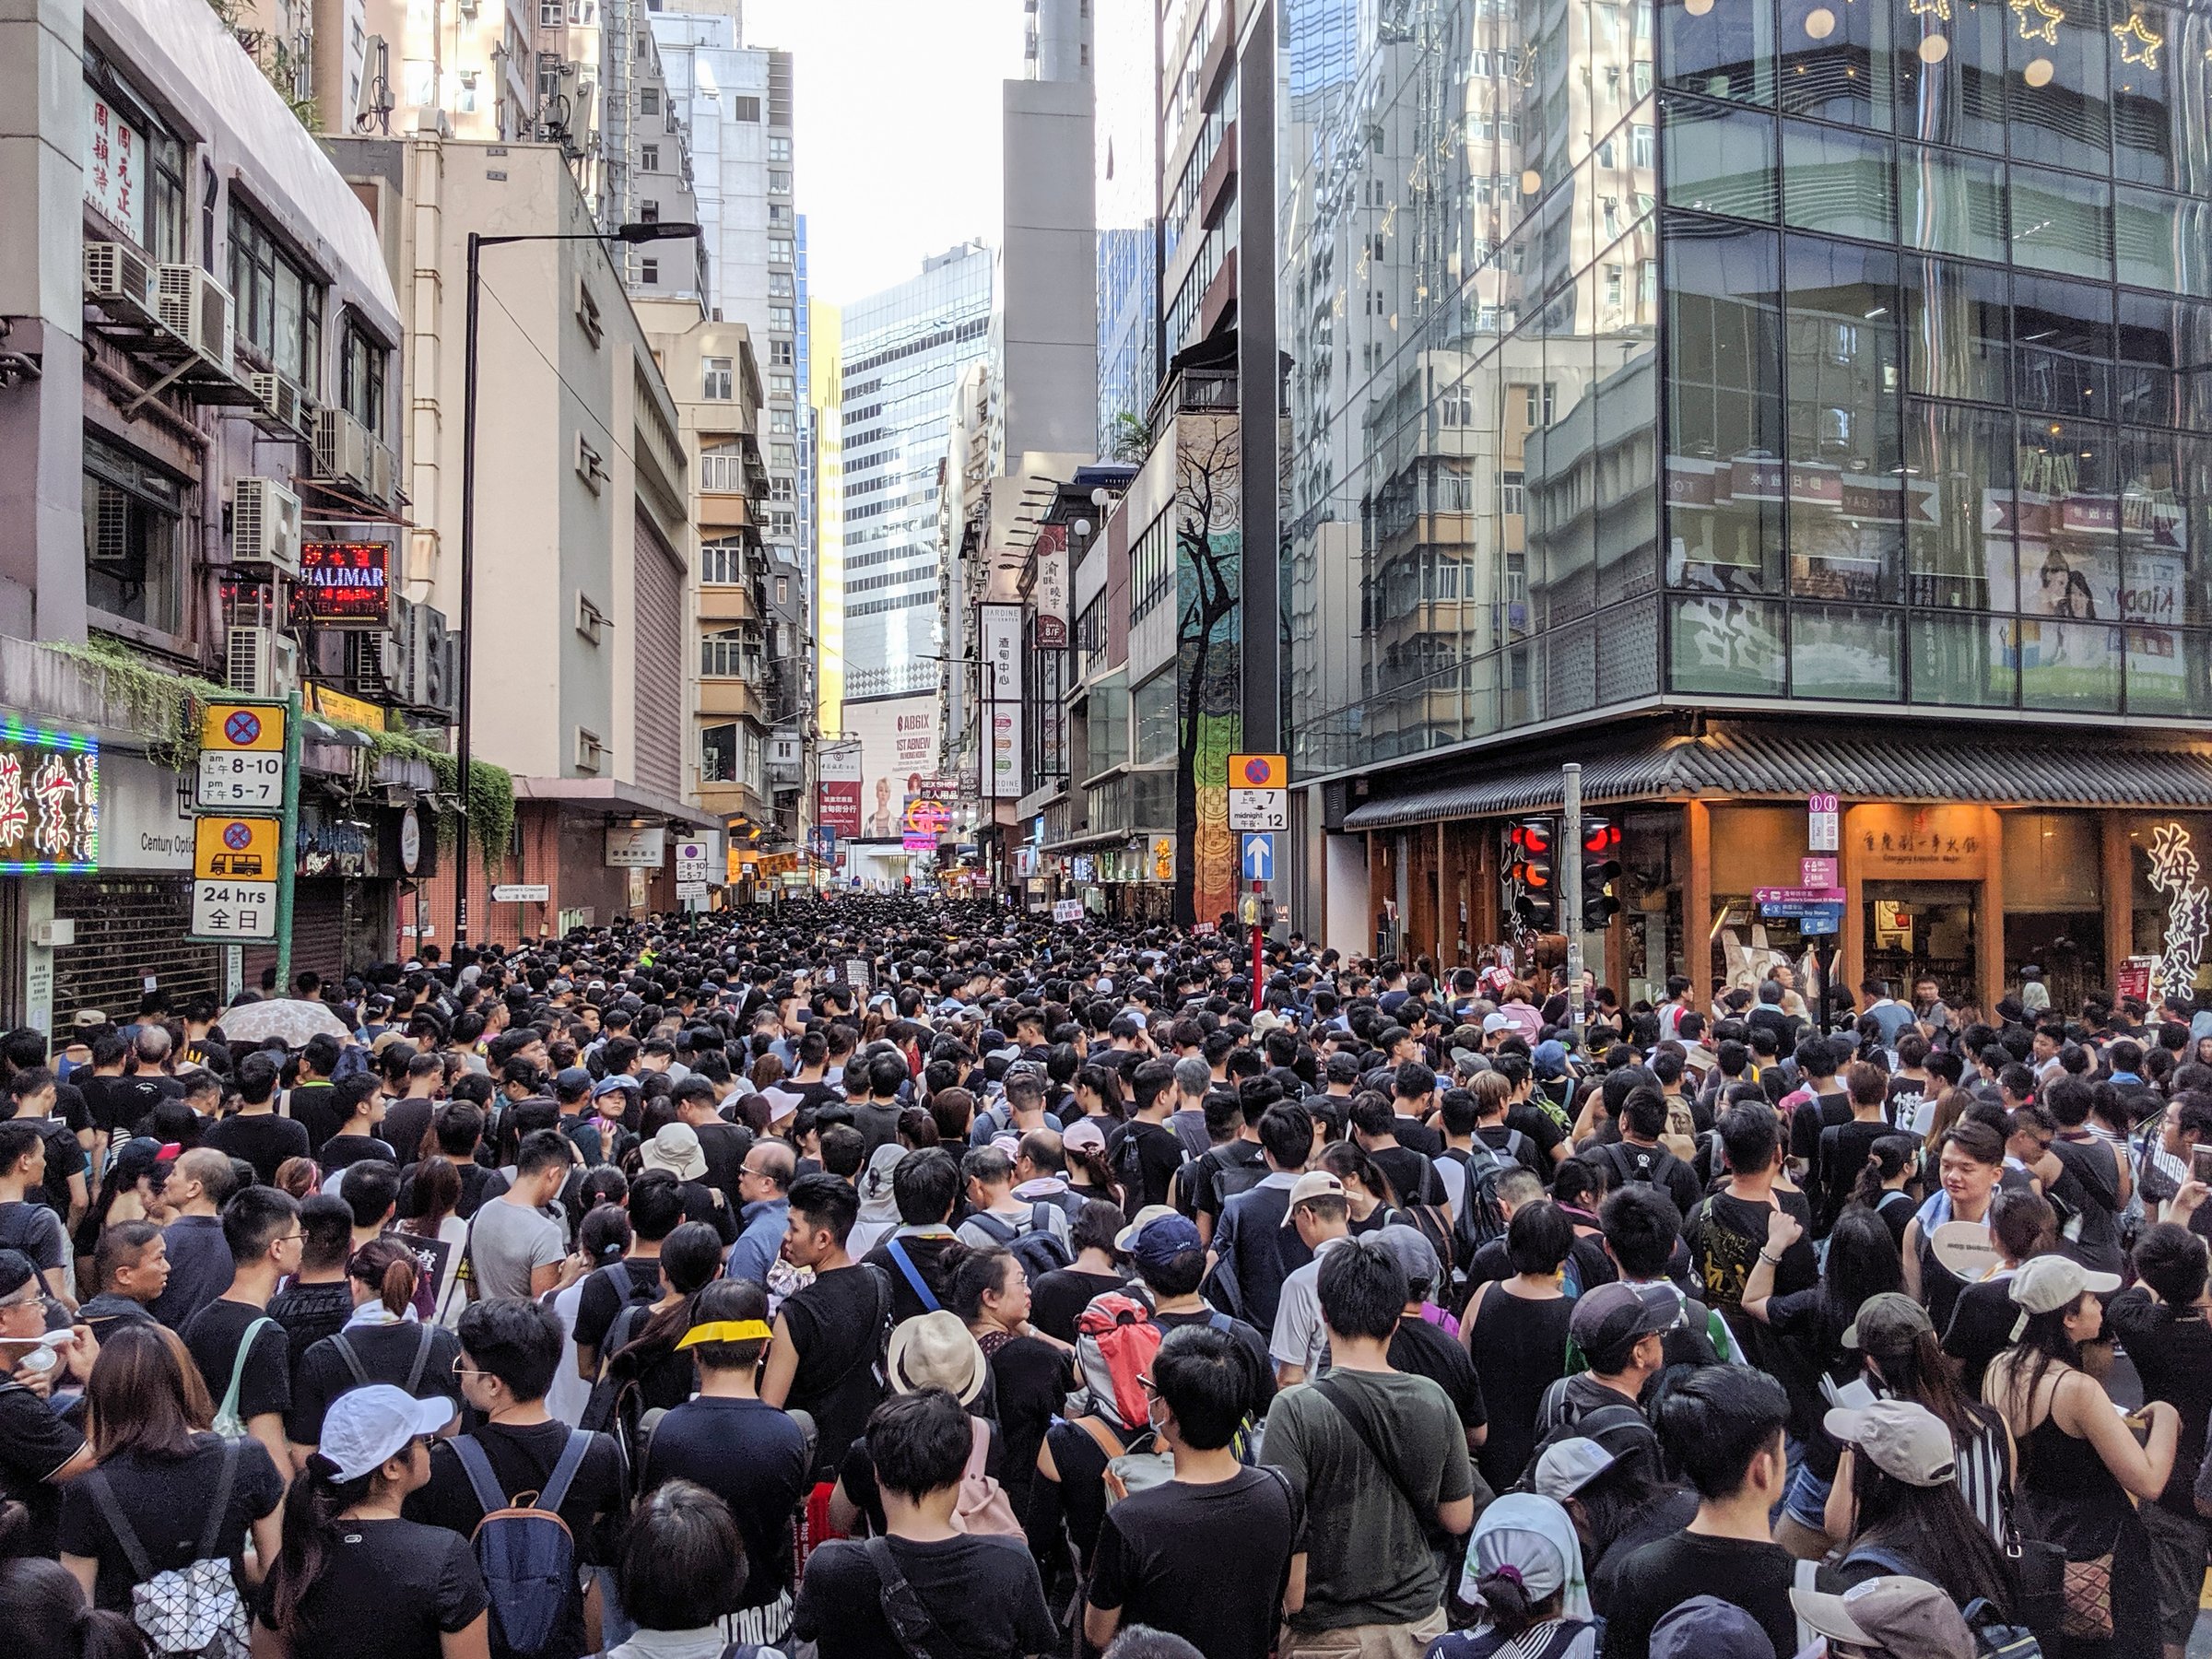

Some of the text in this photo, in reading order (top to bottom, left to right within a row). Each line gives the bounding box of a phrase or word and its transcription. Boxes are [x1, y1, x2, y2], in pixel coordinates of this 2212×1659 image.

[300, 567, 384, 586] HALIMAR
[998, 637, 1010, 686] 渣甸中心
[904, 714, 930, 730] AB6IX
[204, 764, 229, 774] 上午
[232, 759, 279, 774] 8-10
[208, 781, 223, 789] pm
[204, 790, 228, 800] 下午
[922, 791, 959, 800] 成人用品
[1241, 796, 1256, 805] 上午
[1266, 792, 1276, 805] 7
[1234, 812, 1264, 820] midnight
[1267, 814, 1283, 827] 12
[141, 832, 194, 856] Century Optic
[687, 862, 706, 870] 8-10
[204, 887, 266, 903] 24 hrs
[208, 908, 258, 930] 全日
